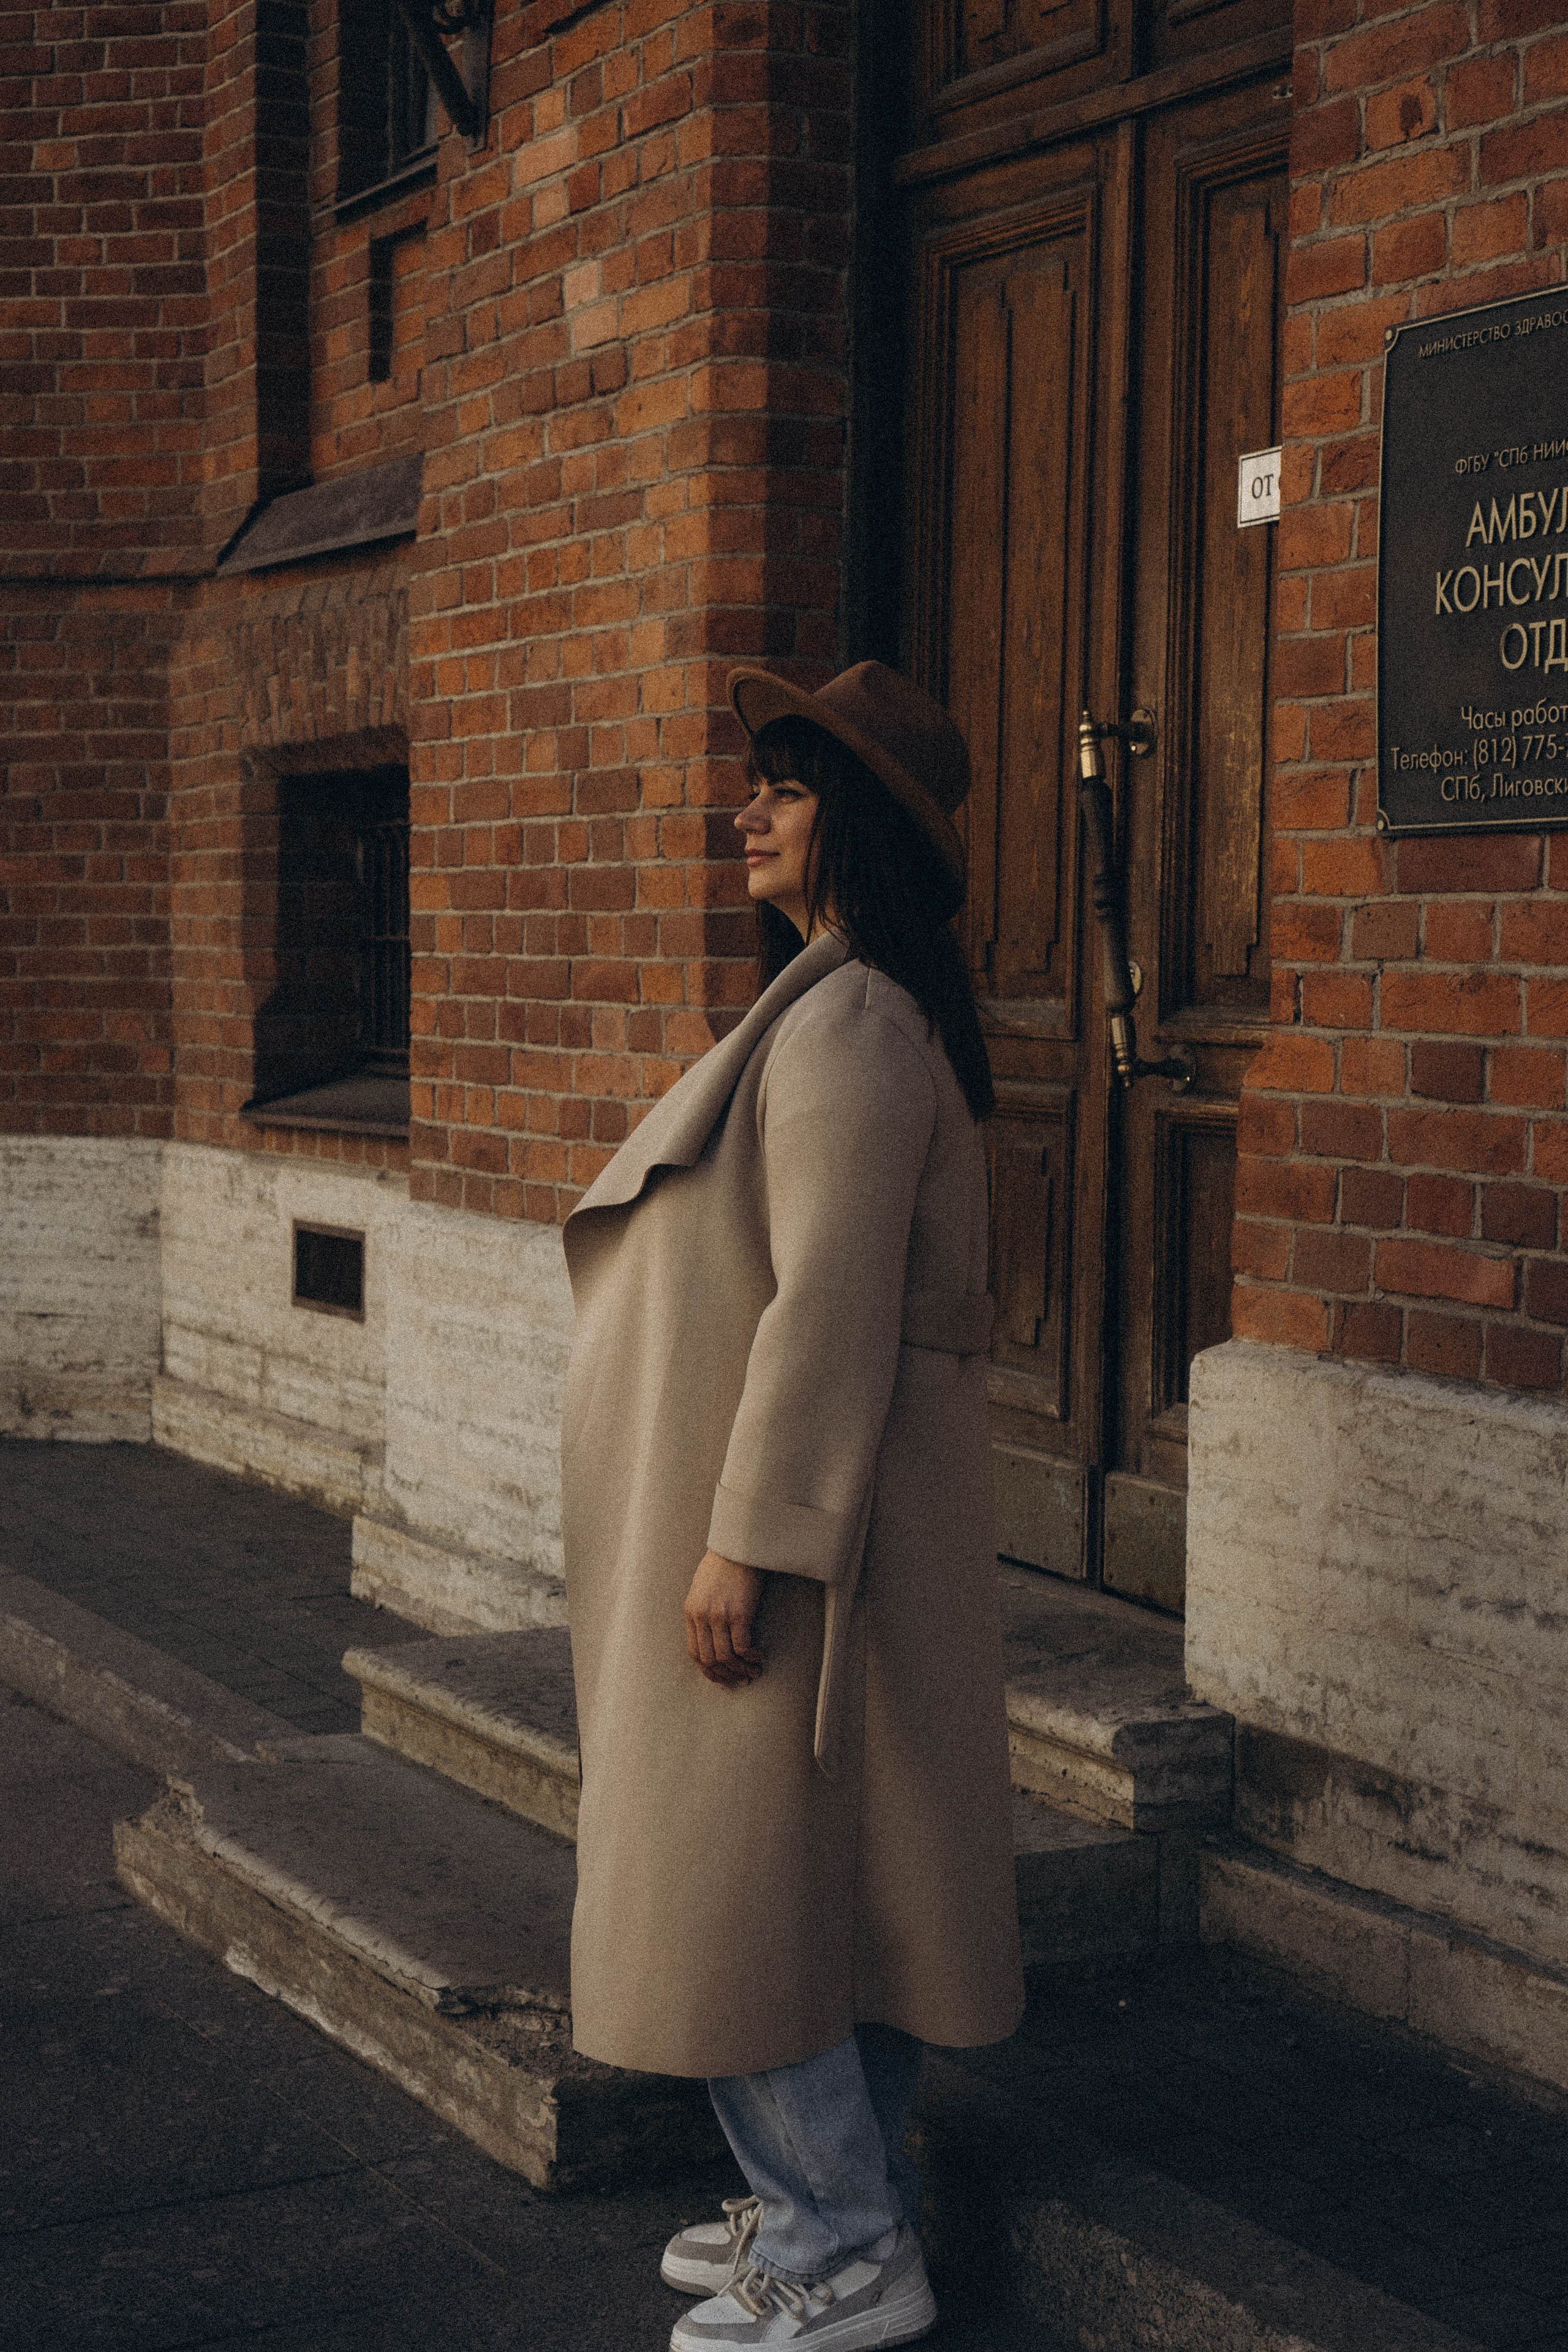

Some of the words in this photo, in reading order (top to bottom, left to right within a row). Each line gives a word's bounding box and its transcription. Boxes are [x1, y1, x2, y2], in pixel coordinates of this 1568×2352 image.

[1419, 324, 1511, 357] МИНИСТЕРСТВО
[1455, 453, 1490, 474] ФГБУ
[1533, 439, 1568, 461] НИИ
[1466, 487, 1568, 548] АМБУЛ
[1435, 552, 1568, 614] КОНСУЛ
[1500, 619, 1568, 674] ОТД
[1461, 706, 1506, 729] Часы
[1512, 697, 1568, 733] работ
[1391, 744, 1468, 774] Телефон:
[1473, 736, 1517, 770] (812)
[1523, 733, 1568, 761] 775-
[1441, 775, 1486, 803] СПб,
